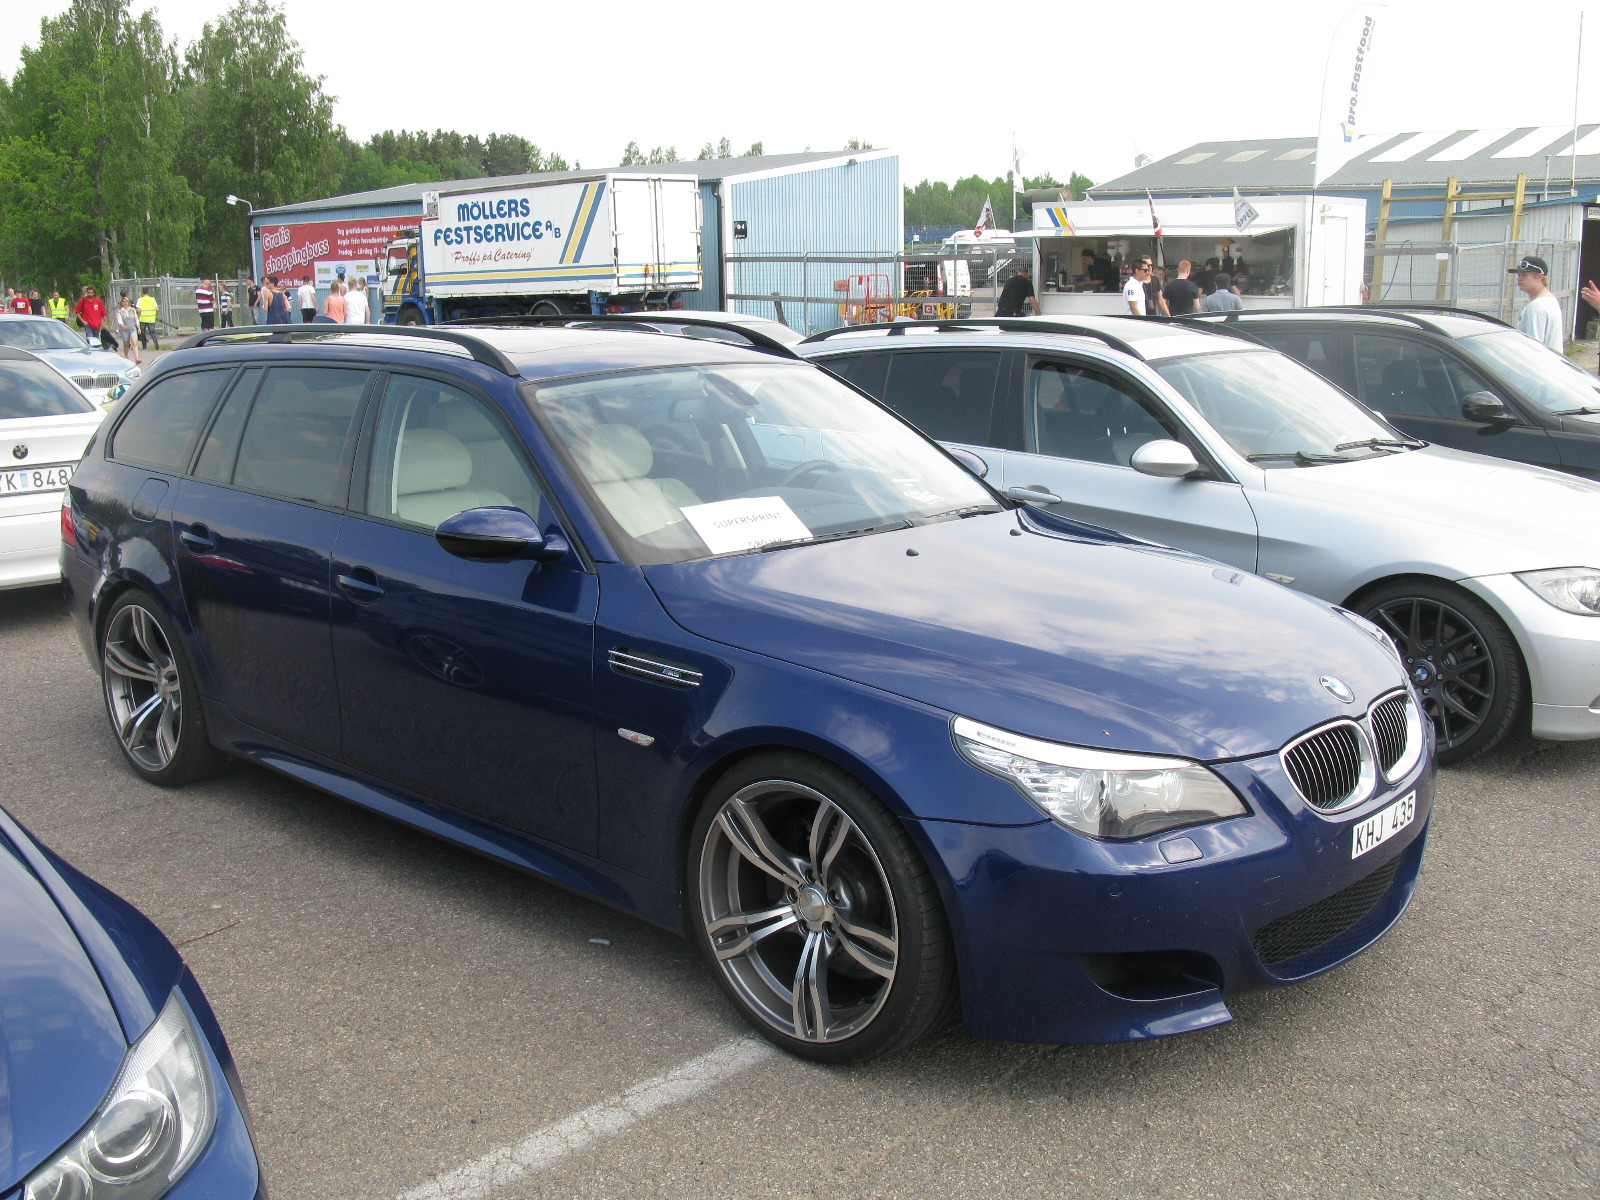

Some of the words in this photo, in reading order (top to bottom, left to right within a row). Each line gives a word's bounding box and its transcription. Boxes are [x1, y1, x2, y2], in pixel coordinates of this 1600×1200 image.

[1347, 15, 1372, 126] pro.Fastfood
[457, 198, 530, 222] MÖLLERS
[263, 227, 291, 251] Gratis
[434, 221, 543, 246] FESTSERVICE
[265, 239, 330, 275] shoppingbuss
[482, 250, 493, 264] på
[33, 468, 69, 489] 848
[713, 512, 782, 528] SUPERSPRINT
[1356, 815, 1383, 854] KHJ
[1392, 795, 1413, 830] 435
